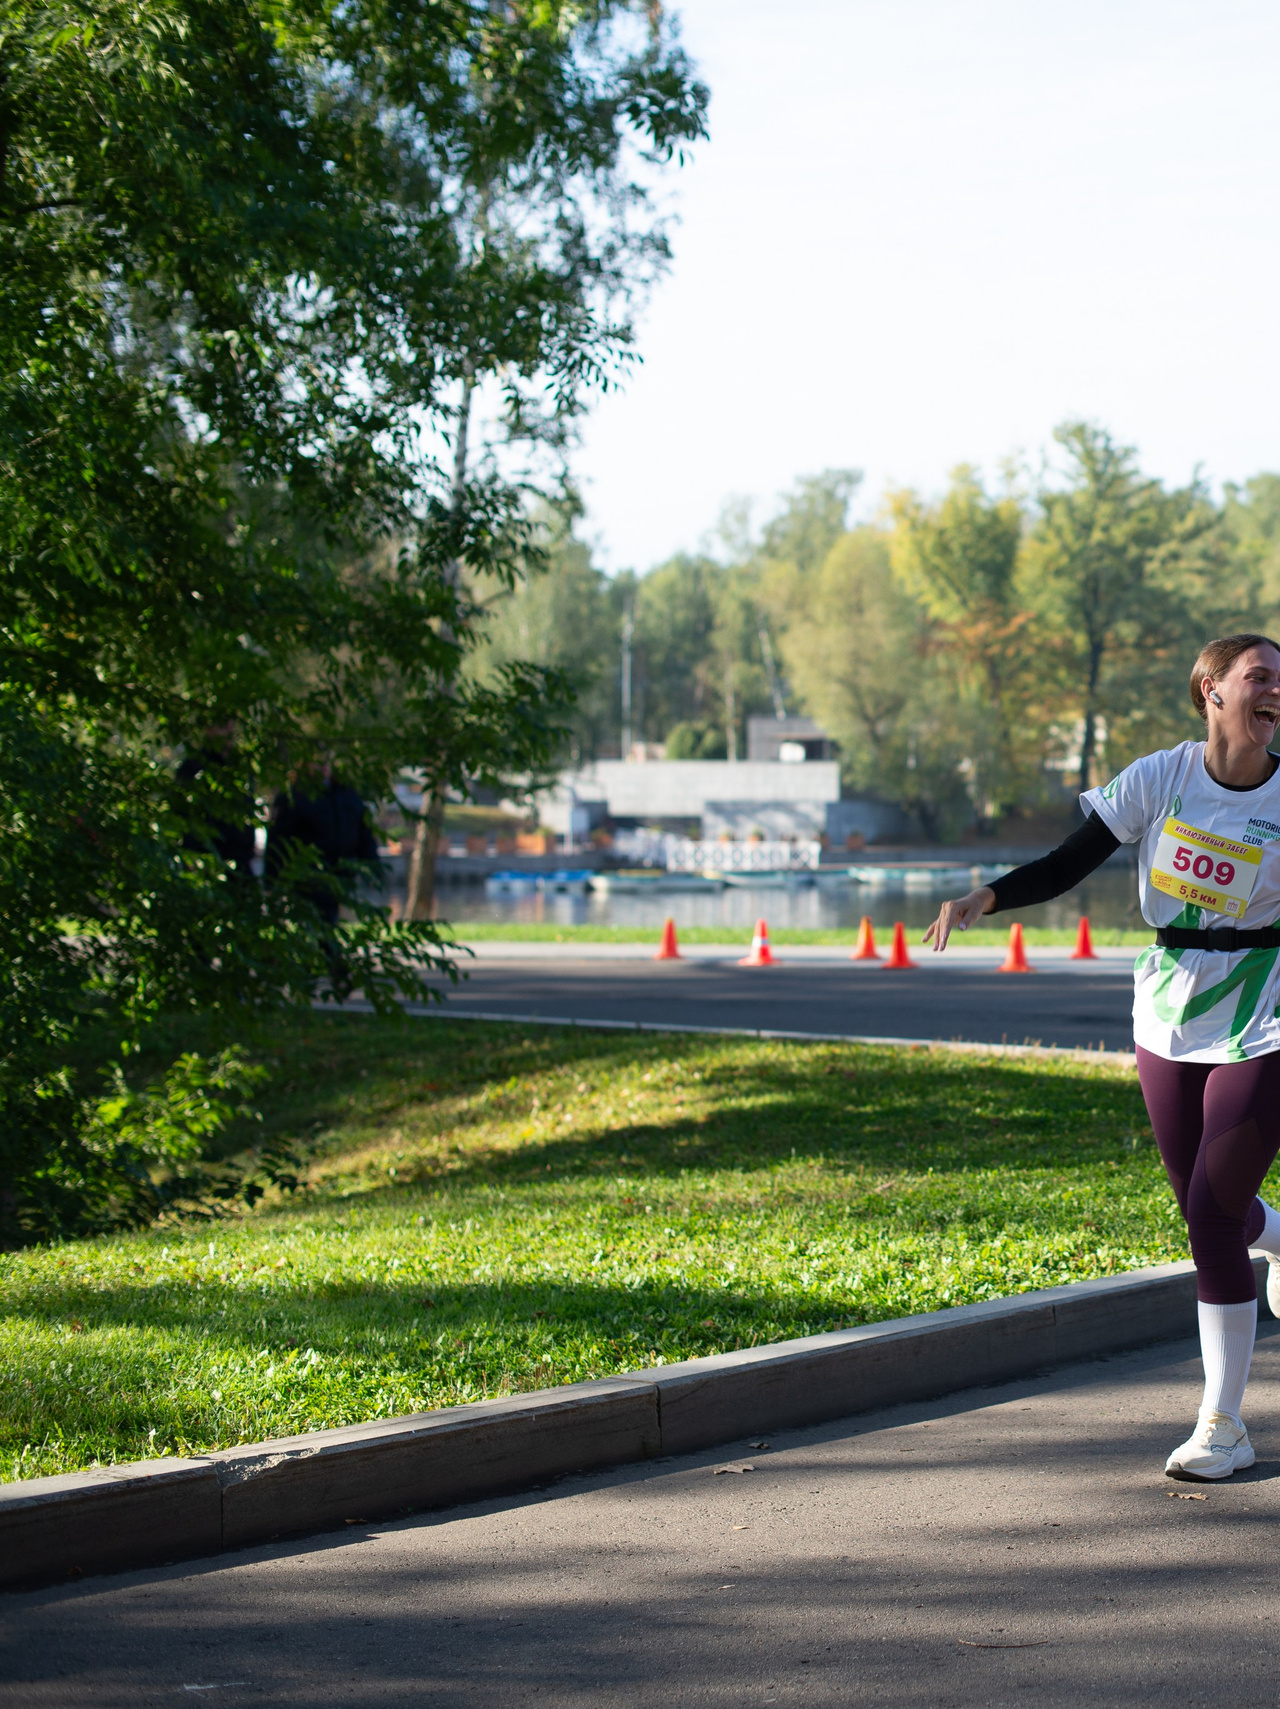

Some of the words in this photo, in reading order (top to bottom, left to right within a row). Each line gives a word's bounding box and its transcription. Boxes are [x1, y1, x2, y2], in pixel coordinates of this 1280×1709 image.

[1245, 826, 1280, 842] RUNNING
[1226, 843, 1249, 855] ЗАБЕГ
[1173, 846, 1235, 885] 509
[1179, 884, 1199, 899] 5,5
